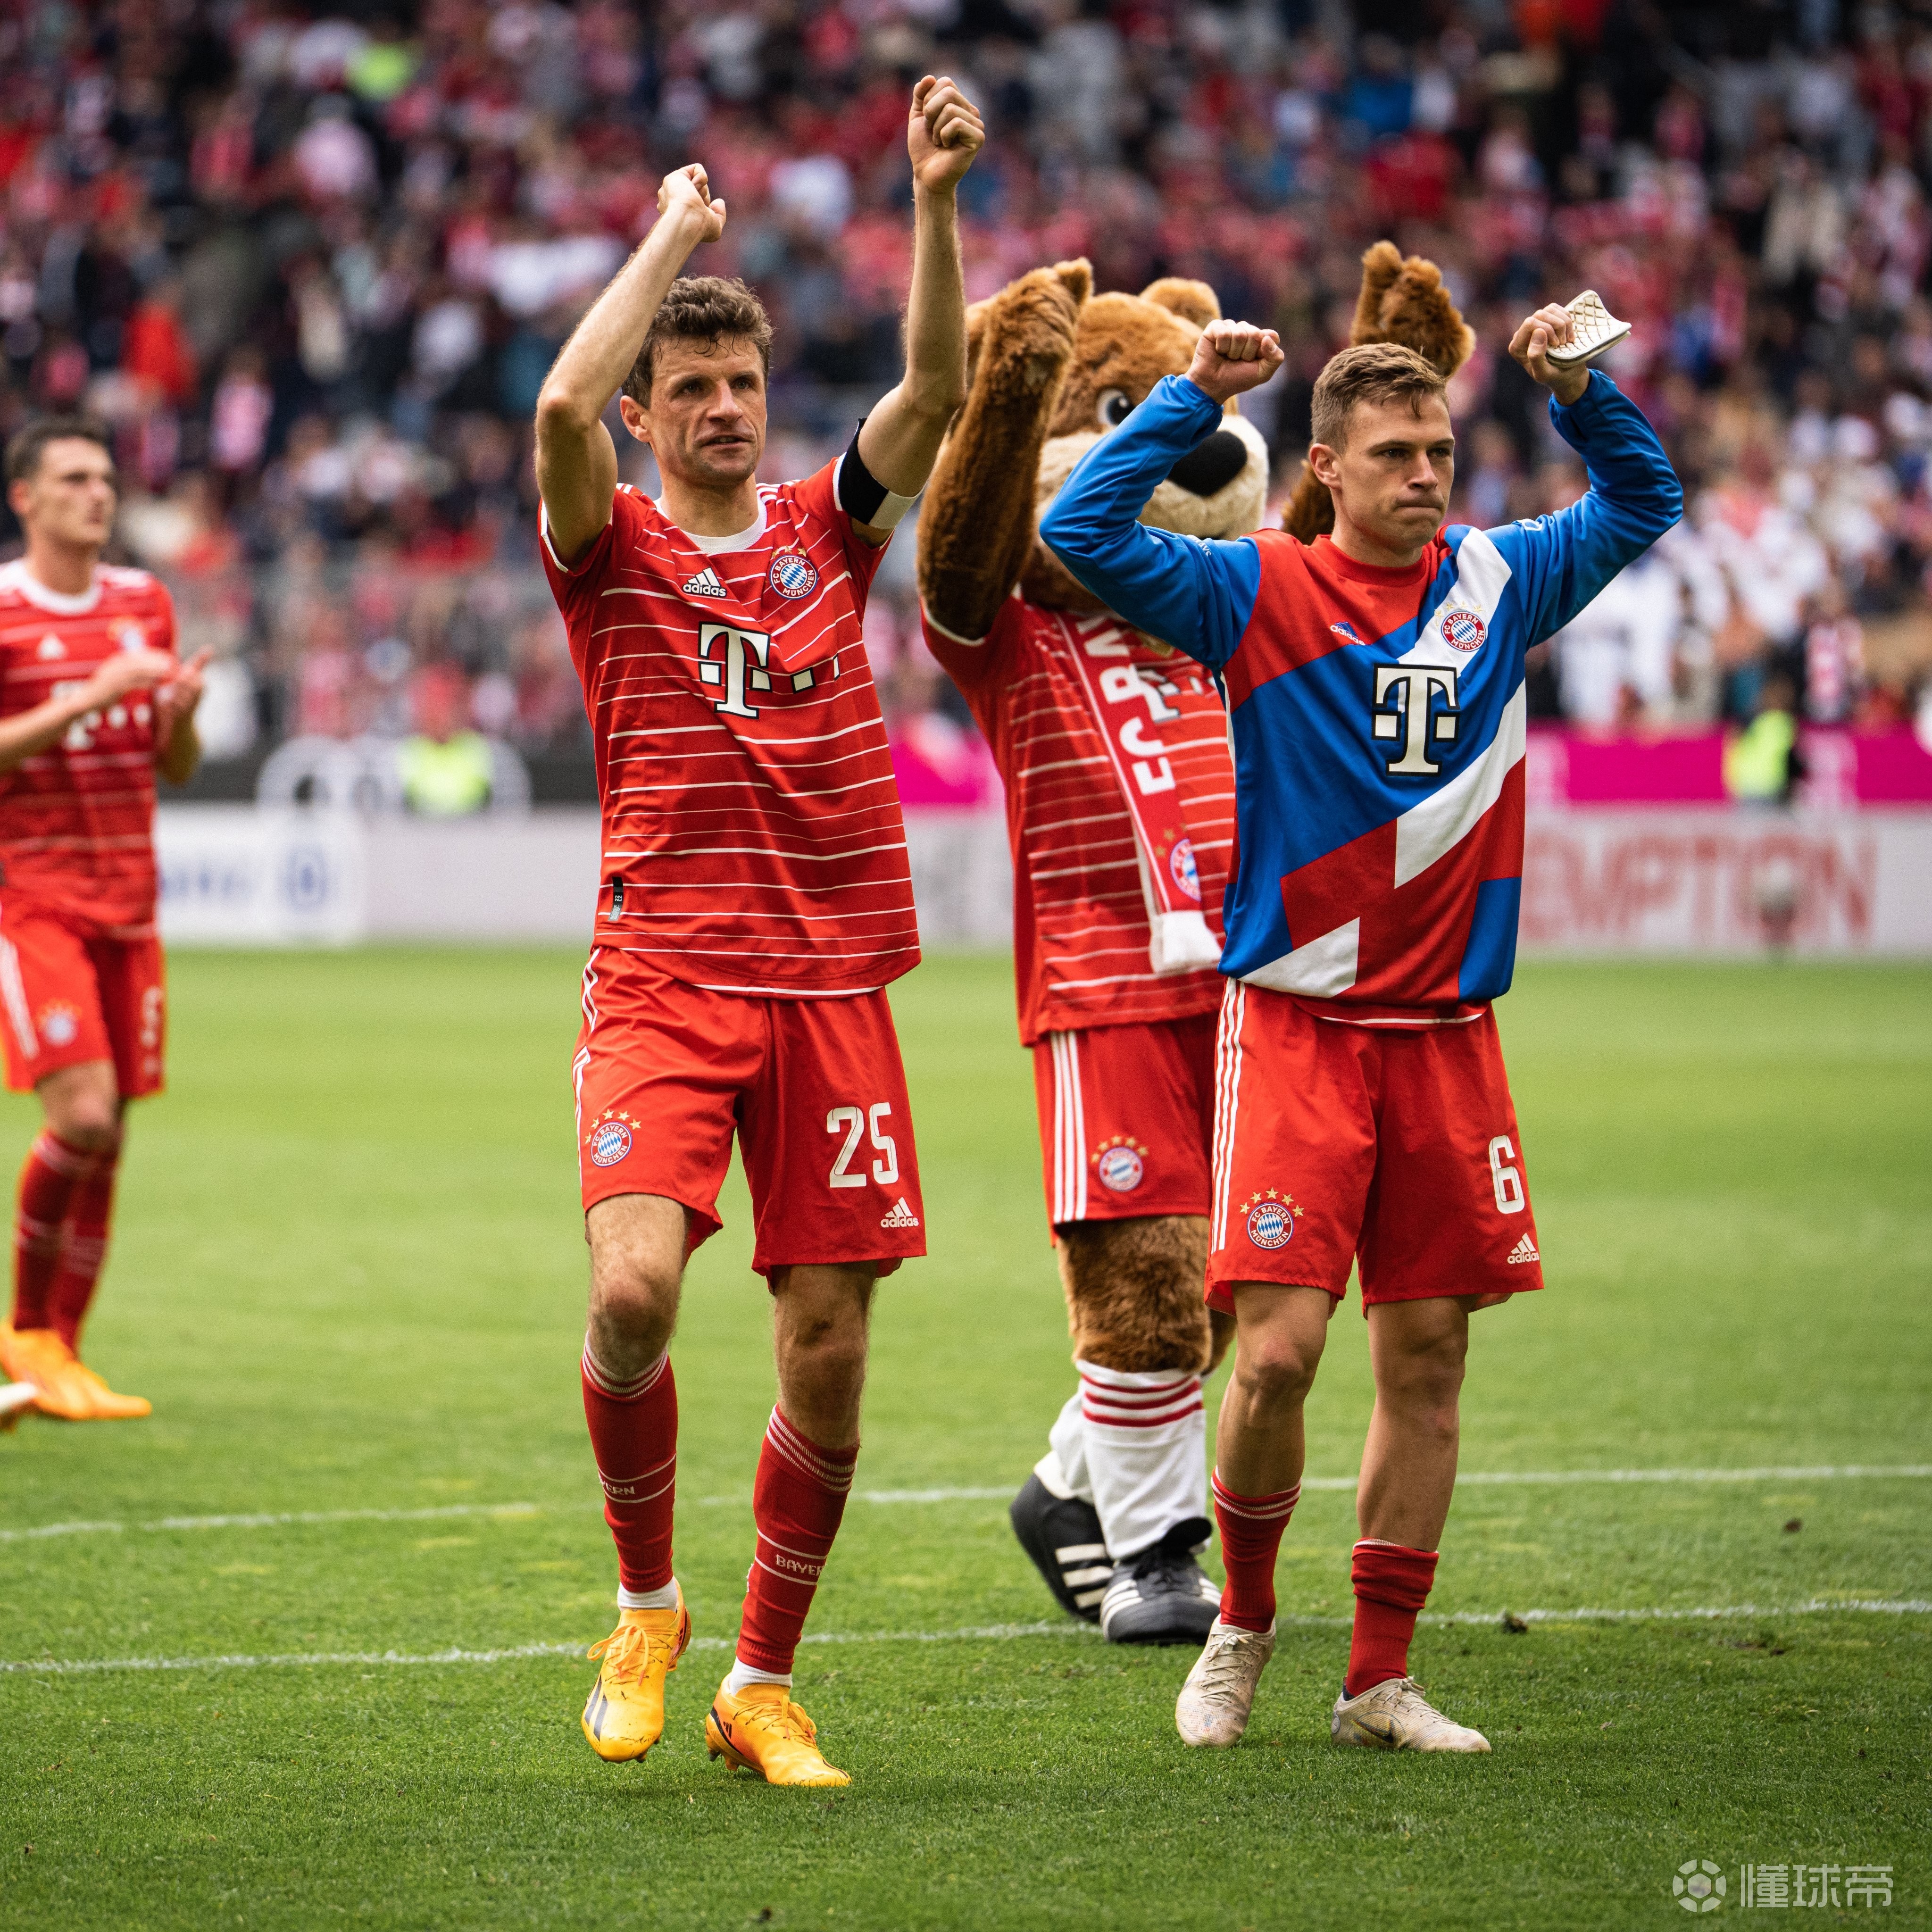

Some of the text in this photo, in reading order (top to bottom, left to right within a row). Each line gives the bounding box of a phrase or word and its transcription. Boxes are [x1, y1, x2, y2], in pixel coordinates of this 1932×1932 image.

[773, 558, 805, 584] FC BAYERN
[683, 583, 726, 597] adidas
[783, 570, 814, 596] MÜNCHEN
[1444, 614, 1479, 634] FC BAYERN
[1330, 625, 1366, 646] adidas
[1451, 630, 1484, 650] MÜNCHEN
[1373, 663, 1460, 776] T
[593, 1125, 628, 1146] FC BAYERN
[827, 1102, 899, 1188] 25
[594, 1145, 628, 1164] MÜNCHEN
[1489, 1135, 1525, 1214] 6
[880, 1216, 919, 1228] adidas
[1252, 1206, 1290, 1224] FC BAYERN
[1251, 1229, 1289, 1246] MÜNCHEN
